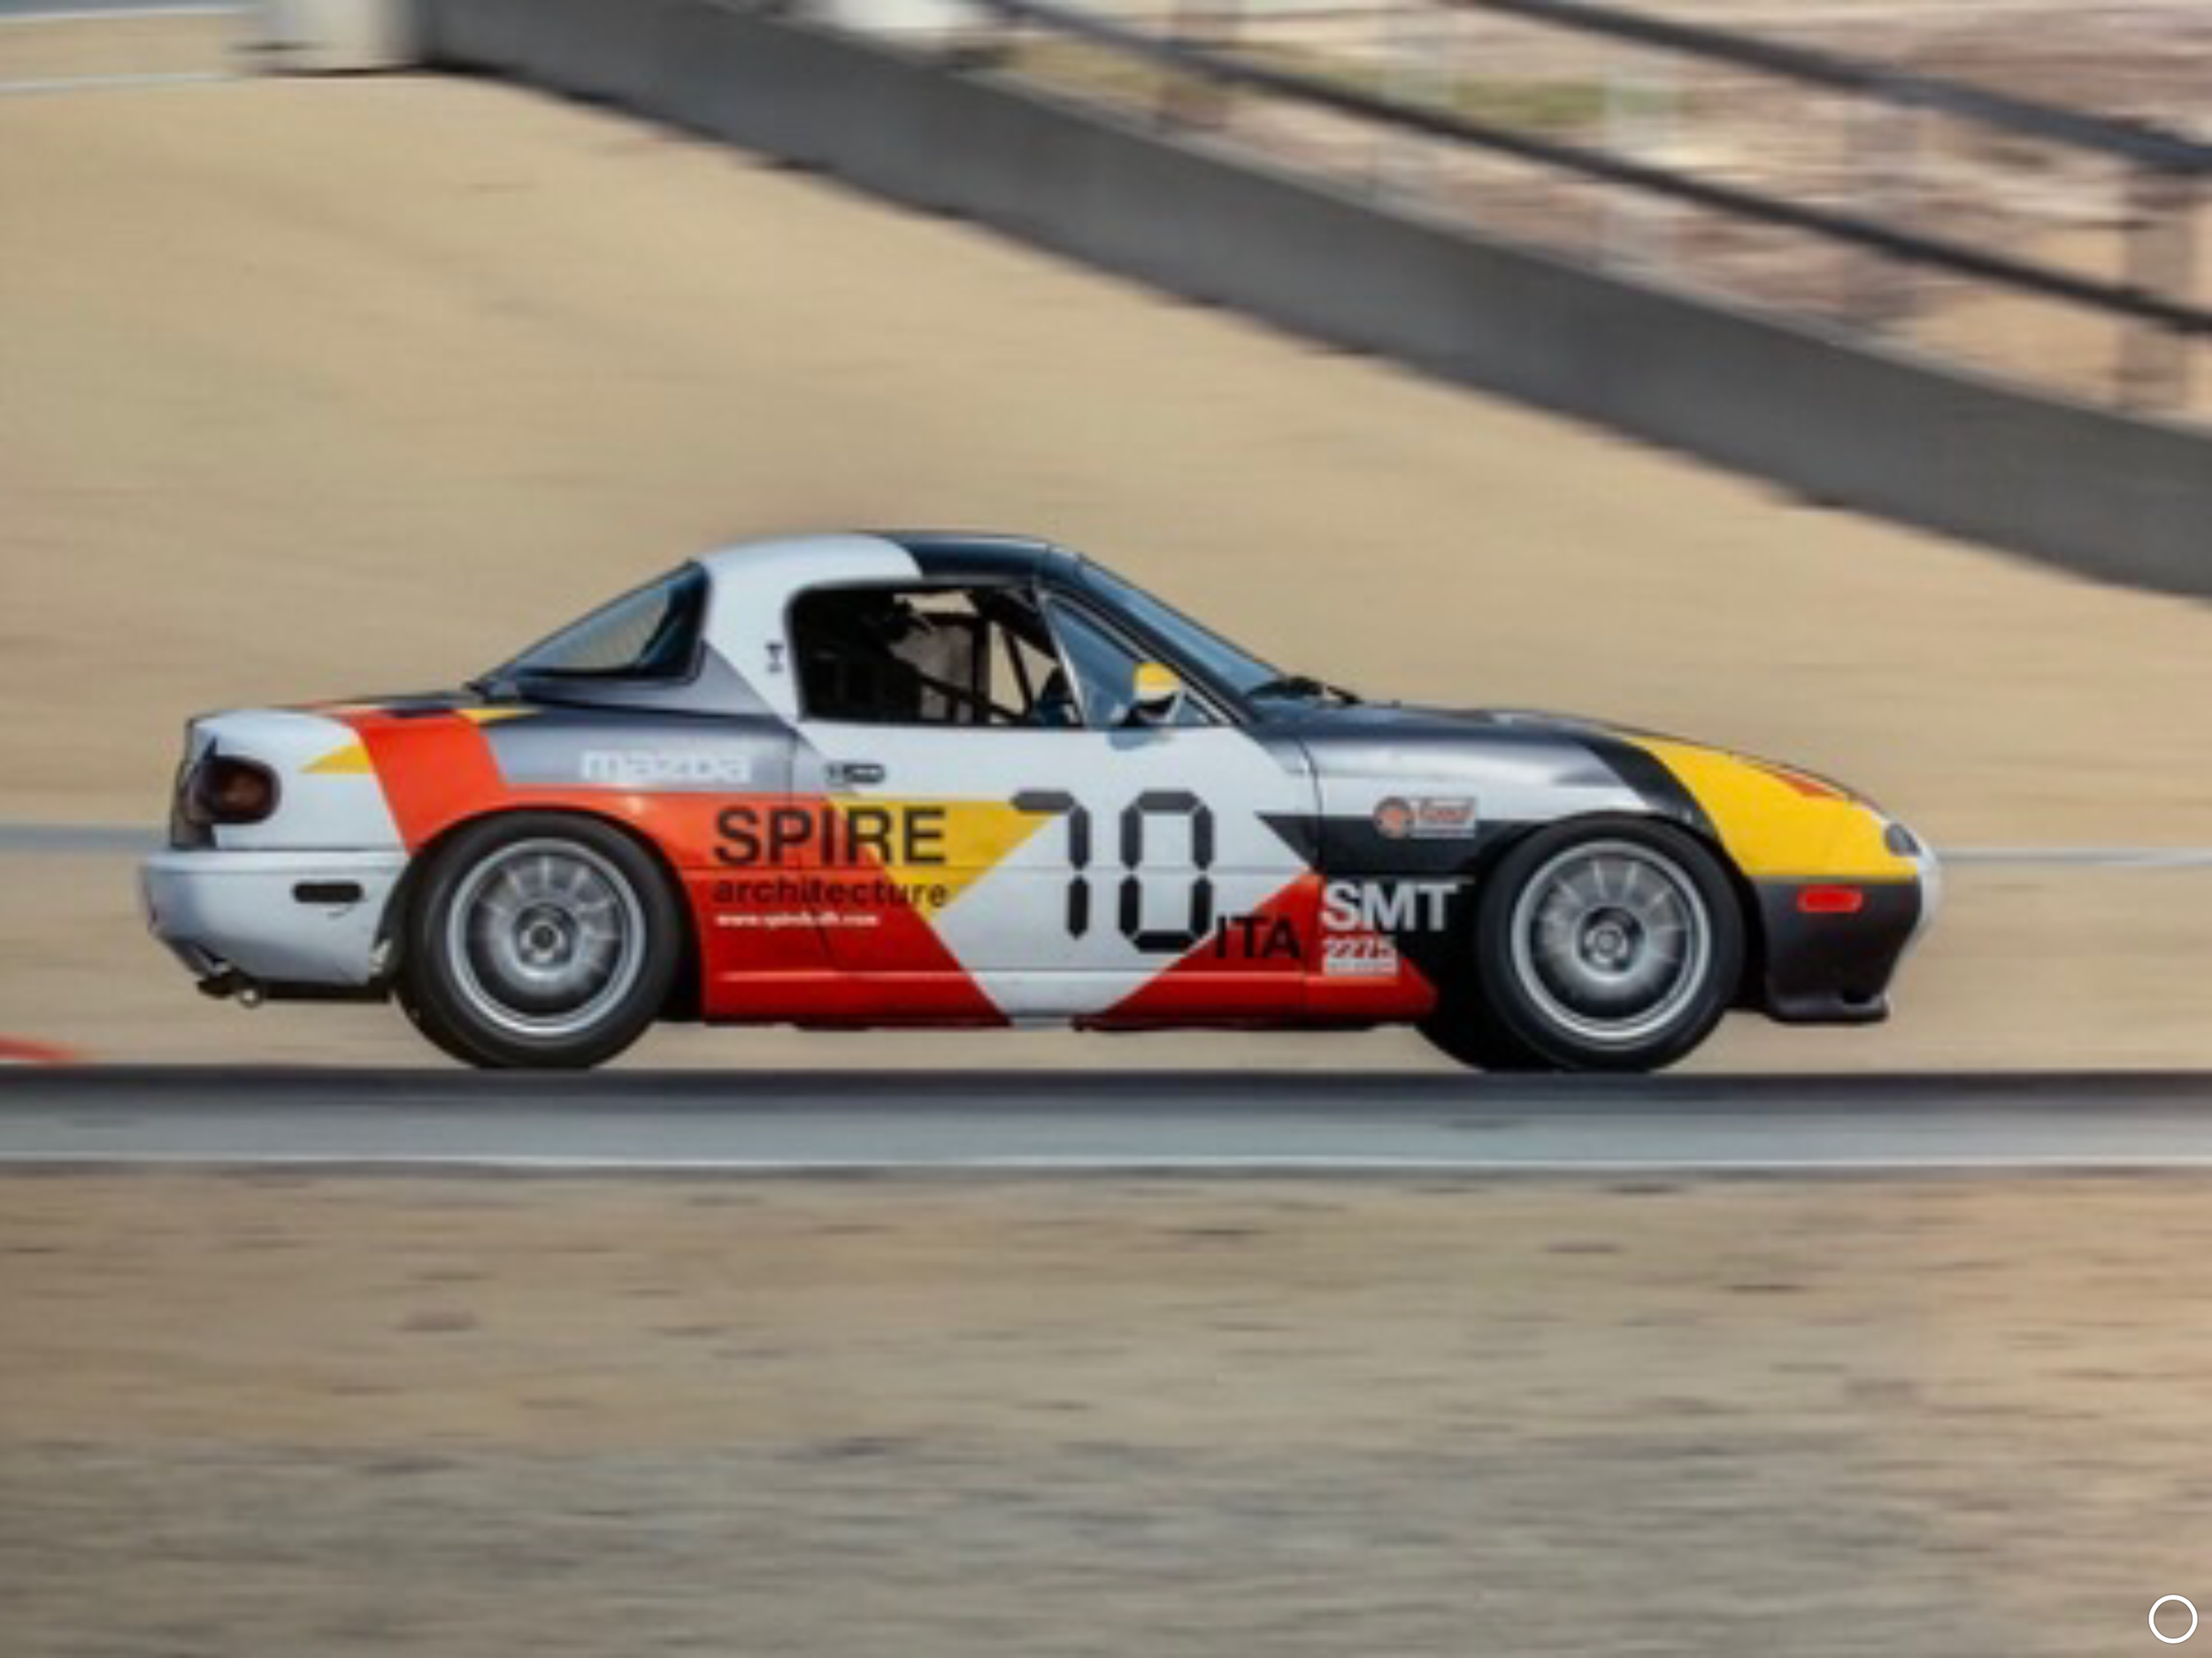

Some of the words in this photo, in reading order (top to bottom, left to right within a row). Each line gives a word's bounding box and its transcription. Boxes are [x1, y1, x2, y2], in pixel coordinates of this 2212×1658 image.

[714, 806, 946, 865] SPIRE
[712, 878, 947, 906] architecture
[1321, 880, 1458, 932] SMT
[1216, 913, 1301, 958] ITA
